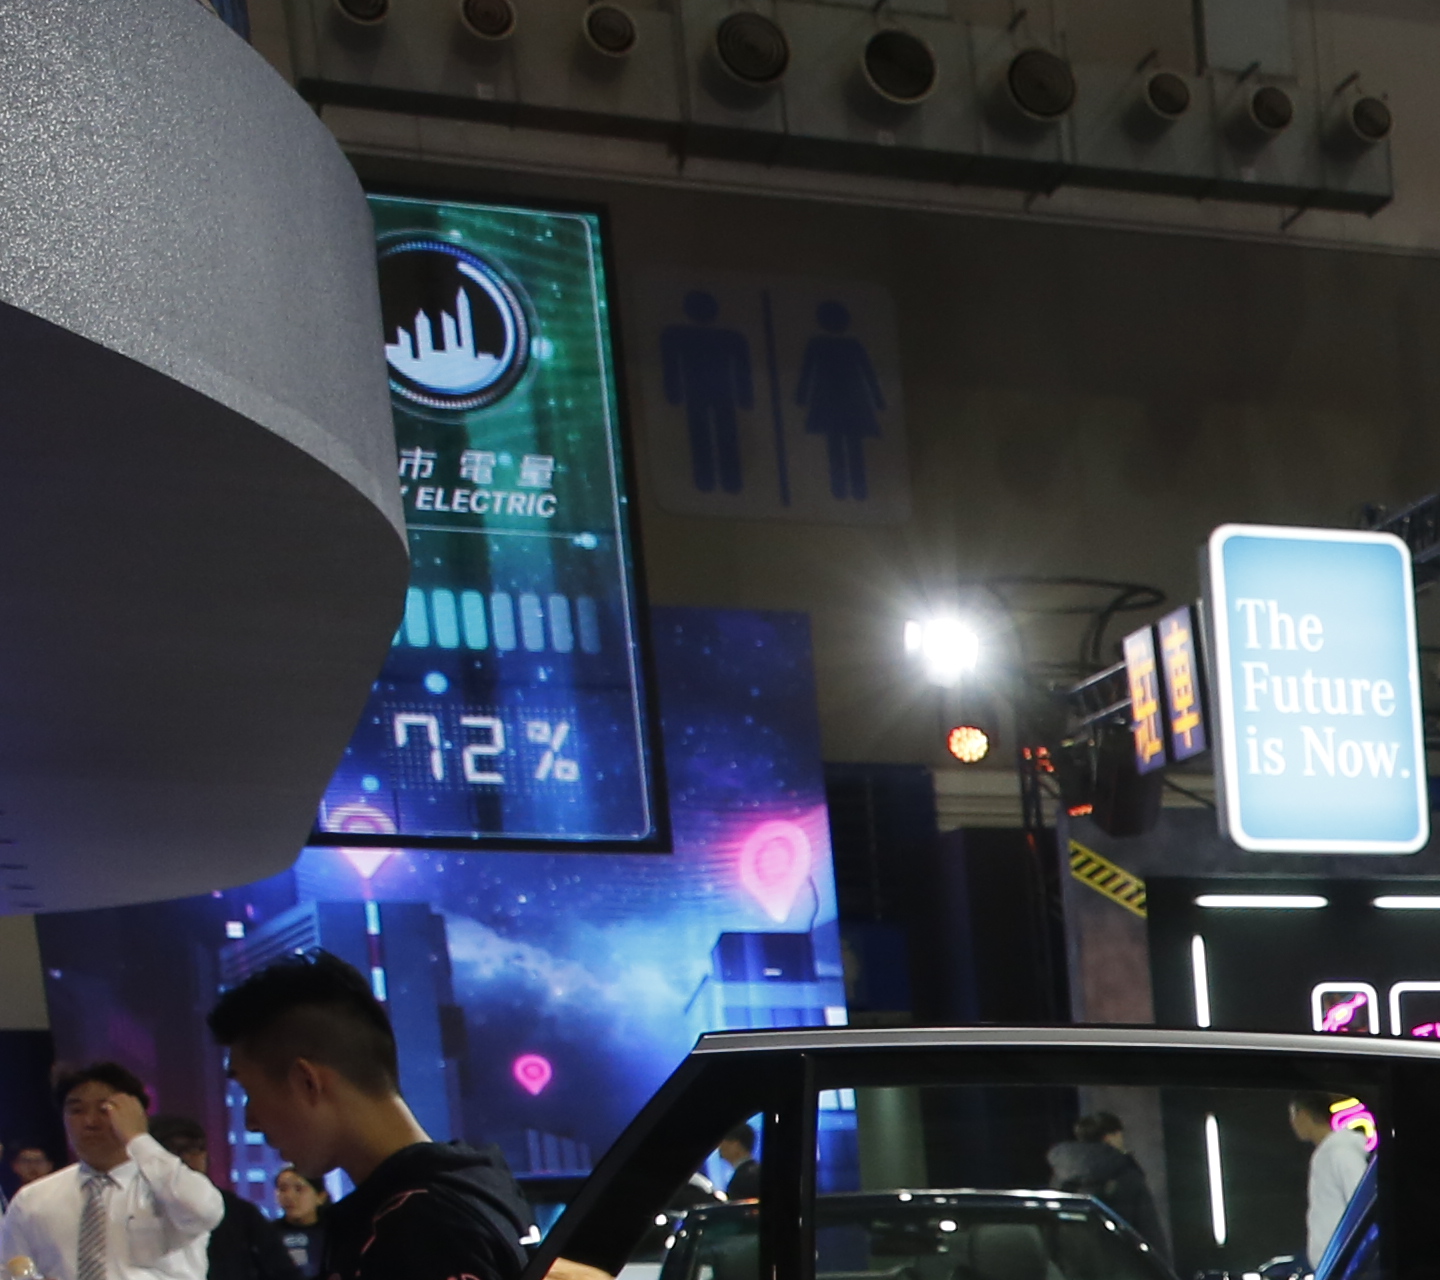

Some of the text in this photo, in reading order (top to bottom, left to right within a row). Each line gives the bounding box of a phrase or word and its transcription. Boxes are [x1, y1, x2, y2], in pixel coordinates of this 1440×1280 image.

[414, 486, 557, 520] ELECTRIC
[1235, 598, 1325, 653] The
[1240, 660, 1397, 718] Future
[394, 712, 505, 784] 72
[1246, 724, 1411, 780] is Now.
